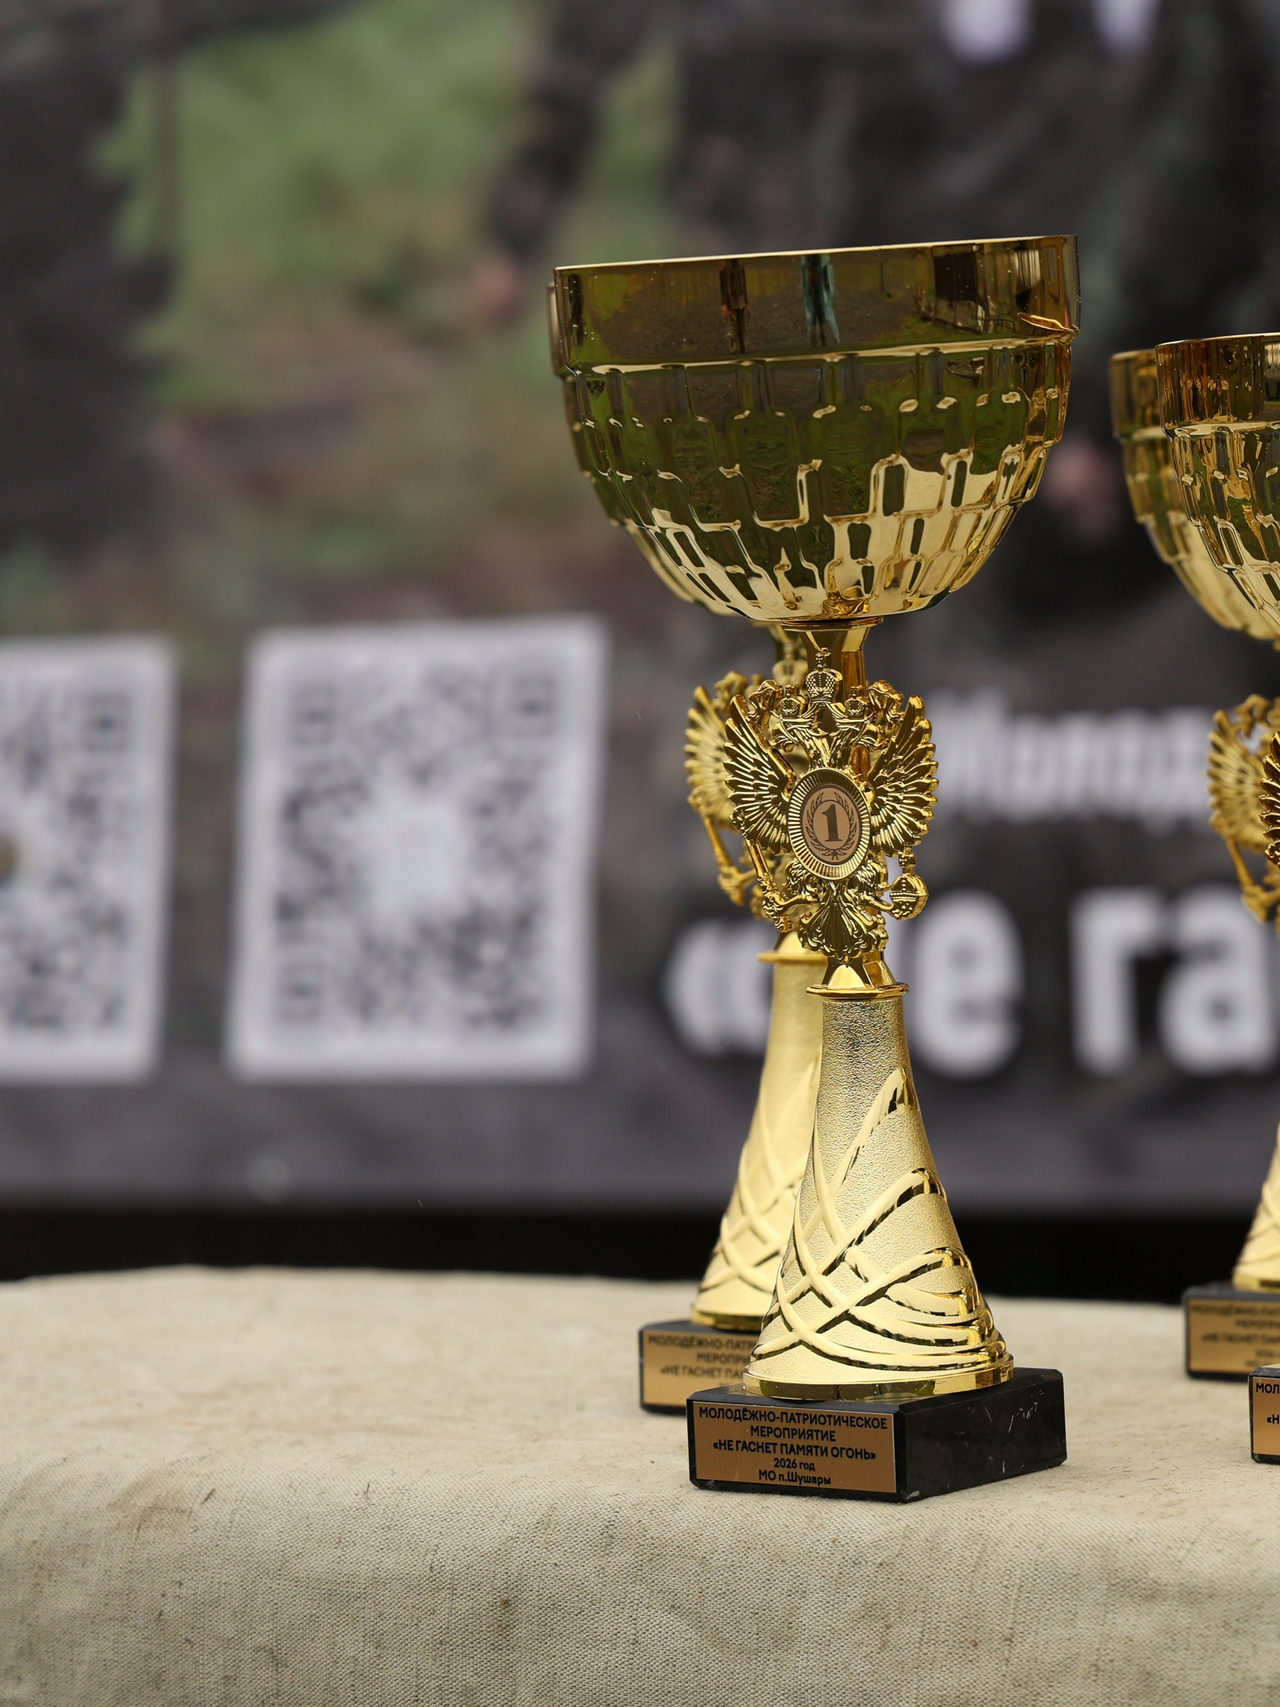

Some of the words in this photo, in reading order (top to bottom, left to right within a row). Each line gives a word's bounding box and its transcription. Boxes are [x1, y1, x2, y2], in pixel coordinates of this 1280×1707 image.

[822, 804, 842, 842] 1
[682, 1366, 723, 1378] ГАСНЕТ
[699, 1407, 887, 1429] МОЛОДЁЖНО-ПАТРИОТИЧЕСКОЕ
[750, 1425, 836, 1442] МЕРОПРИЯТИЕ
[713, 1439, 734, 1451] «НЕ
[735, 1440, 777, 1454] ГАСНЕТ
[780, 1443, 828, 1457] ПАМЯТИ
[830, 1446, 876, 1460] ОГОНЬ»
[774, 1457, 797, 1469] 2026
[799, 1462, 815, 1471] год
[759, 1469, 776, 1481] МО
[778, 1471, 831, 1486] п.Шушары
